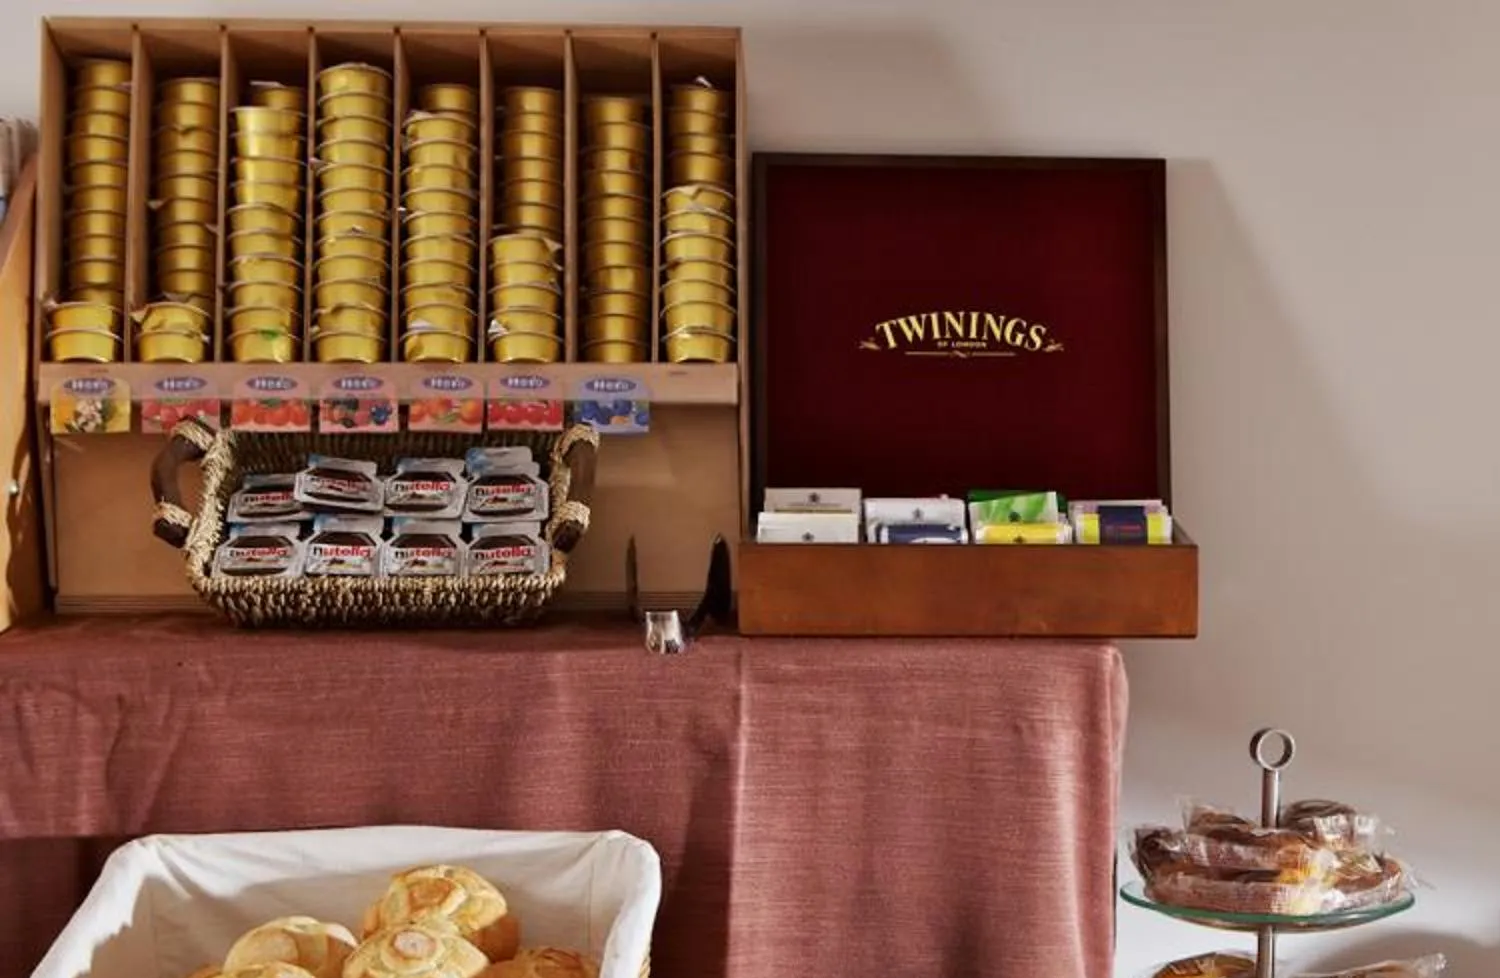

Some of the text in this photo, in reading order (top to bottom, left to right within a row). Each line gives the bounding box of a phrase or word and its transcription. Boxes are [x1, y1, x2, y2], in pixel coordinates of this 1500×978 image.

[875, 311, 1047, 351] TWININGS
[952, 341, 987, 349] LONDON
[394, 480, 452, 492] nutella
[475, 483, 534, 496] nutella
[244, 492, 295, 502] nutell
[229, 545, 288, 557] nutella
[313, 544, 373, 559] nutella
[395, 546, 454, 558] nutella
[474, 546, 534, 560] nutella
